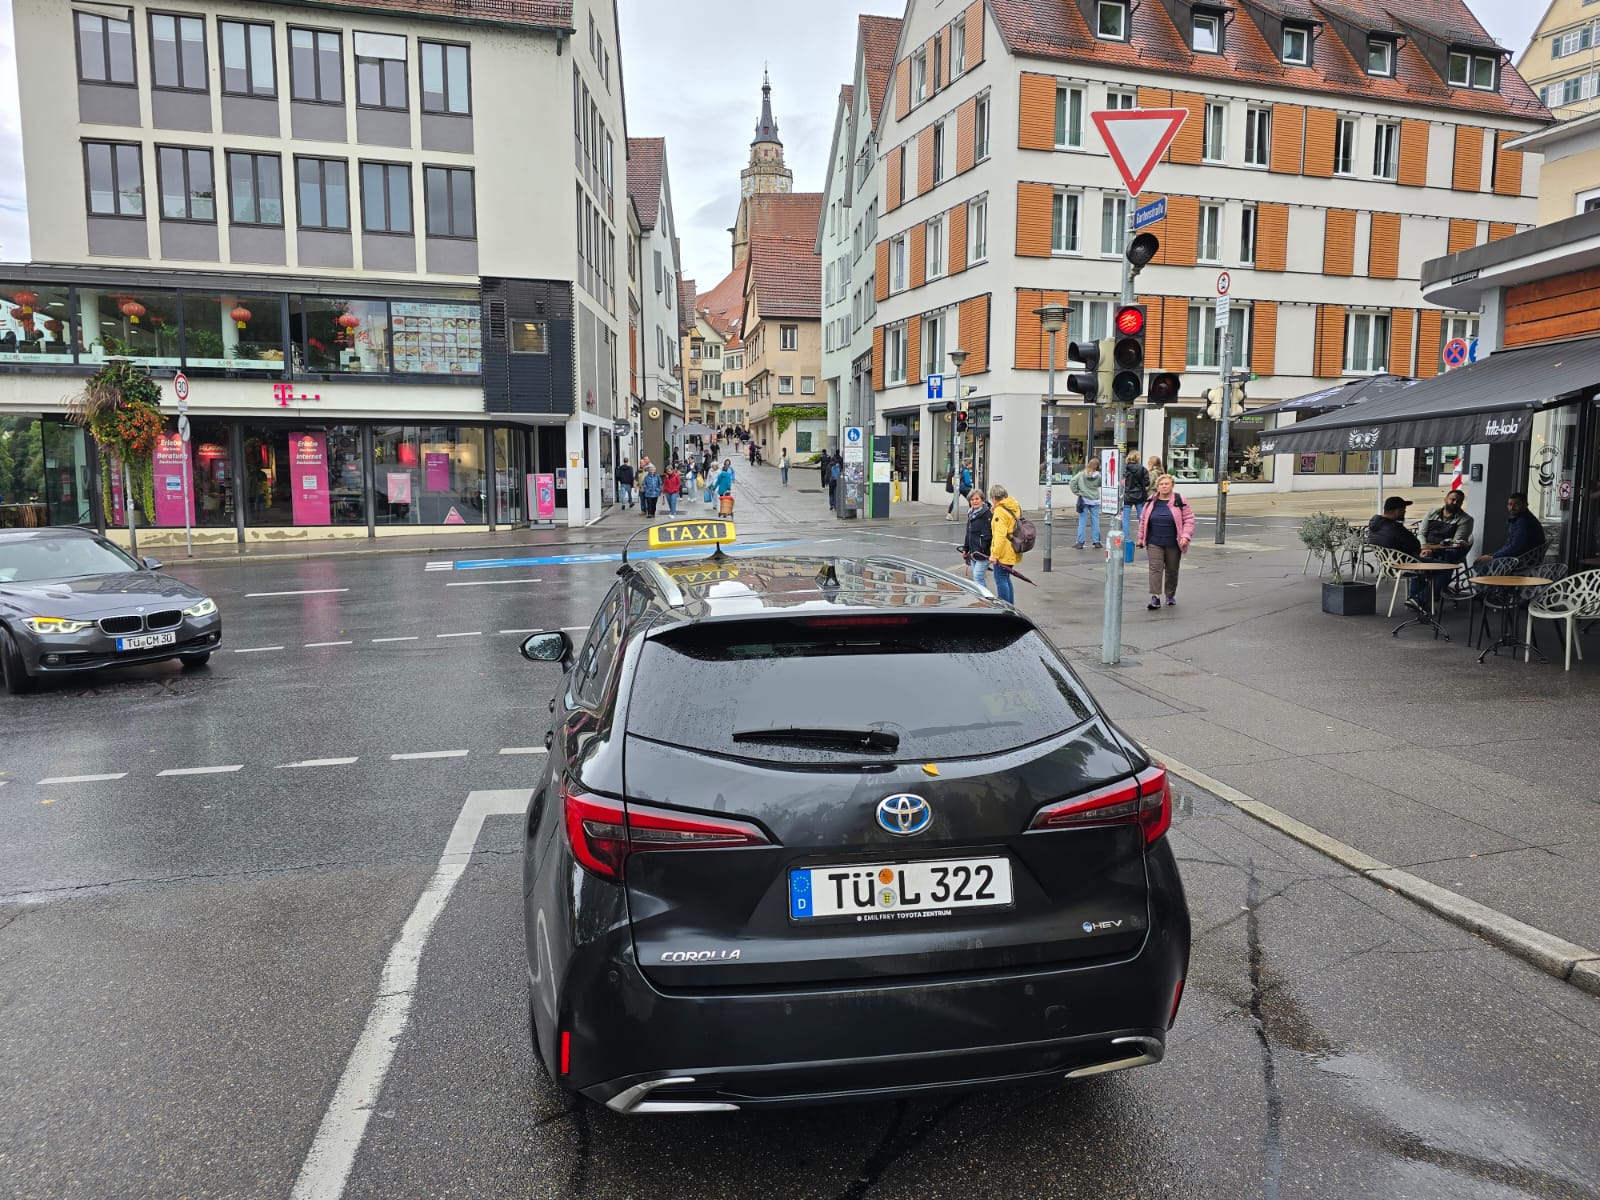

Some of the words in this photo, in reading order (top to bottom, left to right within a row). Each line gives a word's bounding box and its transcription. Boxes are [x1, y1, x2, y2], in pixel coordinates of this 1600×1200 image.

[1136, 202, 1164, 224] Gartenstraße
[177, 380, 186, 394] 30
[666, 525, 718, 541] TAXI
[146, 636, 159, 645] CM
[160, 634, 172, 643] 30
[828, 871, 876, 909] TÜ
[898, 870, 921, 906] L
[930, 864, 995, 903] 322
[797, 898, 806, 910] D
[896, 911, 922, 919] TOYOTA
[922, 909, 952, 918] ZENTRUM
[1092, 919, 1122, 930] HEV
[661, 949, 741, 962] COROLLA
